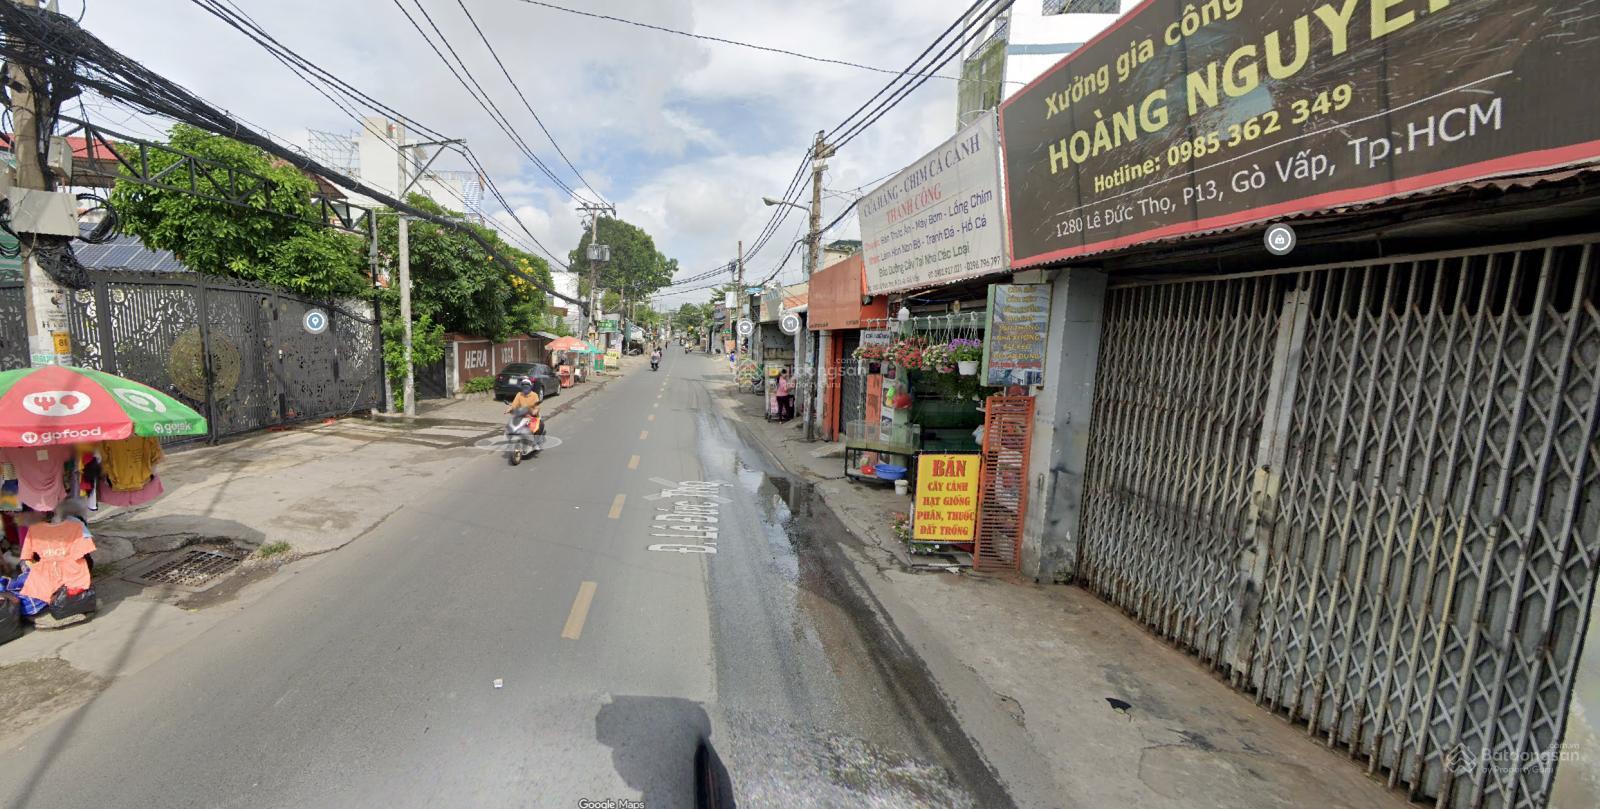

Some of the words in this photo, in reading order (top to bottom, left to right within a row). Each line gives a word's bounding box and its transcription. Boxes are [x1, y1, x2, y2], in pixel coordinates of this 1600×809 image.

[1044, 64, 1109, 119] Xưởng
[1116, 39, 1154, 82] gia
[1164, 0, 1242, 46] công
[1048, 89, 1169, 174] HOÀNG
[1187, 0, 1450, 117] NGUY
[1094, 157, 1160, 193] Hotline:
[1167, 136, 1220, 167] 0985
[1227, 110, 1281, 148] 362
[1292, 84, 1352, 124] 349
[904, 166, 927, 192] CHIM
[930, 151, 943, 177] CÁ
[1056, 217, 1083, 238] 1280
[1087, 209, 1102, 230] Lê
[1105, 204, 1134, 227] Đức
[1137, 196, 1176, 217] Thọ,
[1183, 180, 1224, 205] P13,
[1231, 164, 1266, 193] Gò
[1275, 149, 1336, 182] Vấp,
[1347, 97, 1502, 169] Tp.HCM
[970, 190, 993, 209] Chim
[975, 213, 987, 230] Cá
[464, 349, 487, 368] HERA
[41, 426, 102, 441] gofood
[164, 423, 193, 434] gojek
[932, 456, 967, 477] BÁN
[928, 481, 943, 492] CÂY
[923, 496, 941, 507] HẠT
[947, 508, 975, 521] THUỐC
[940, 524, 968, 536] TRỒNG
